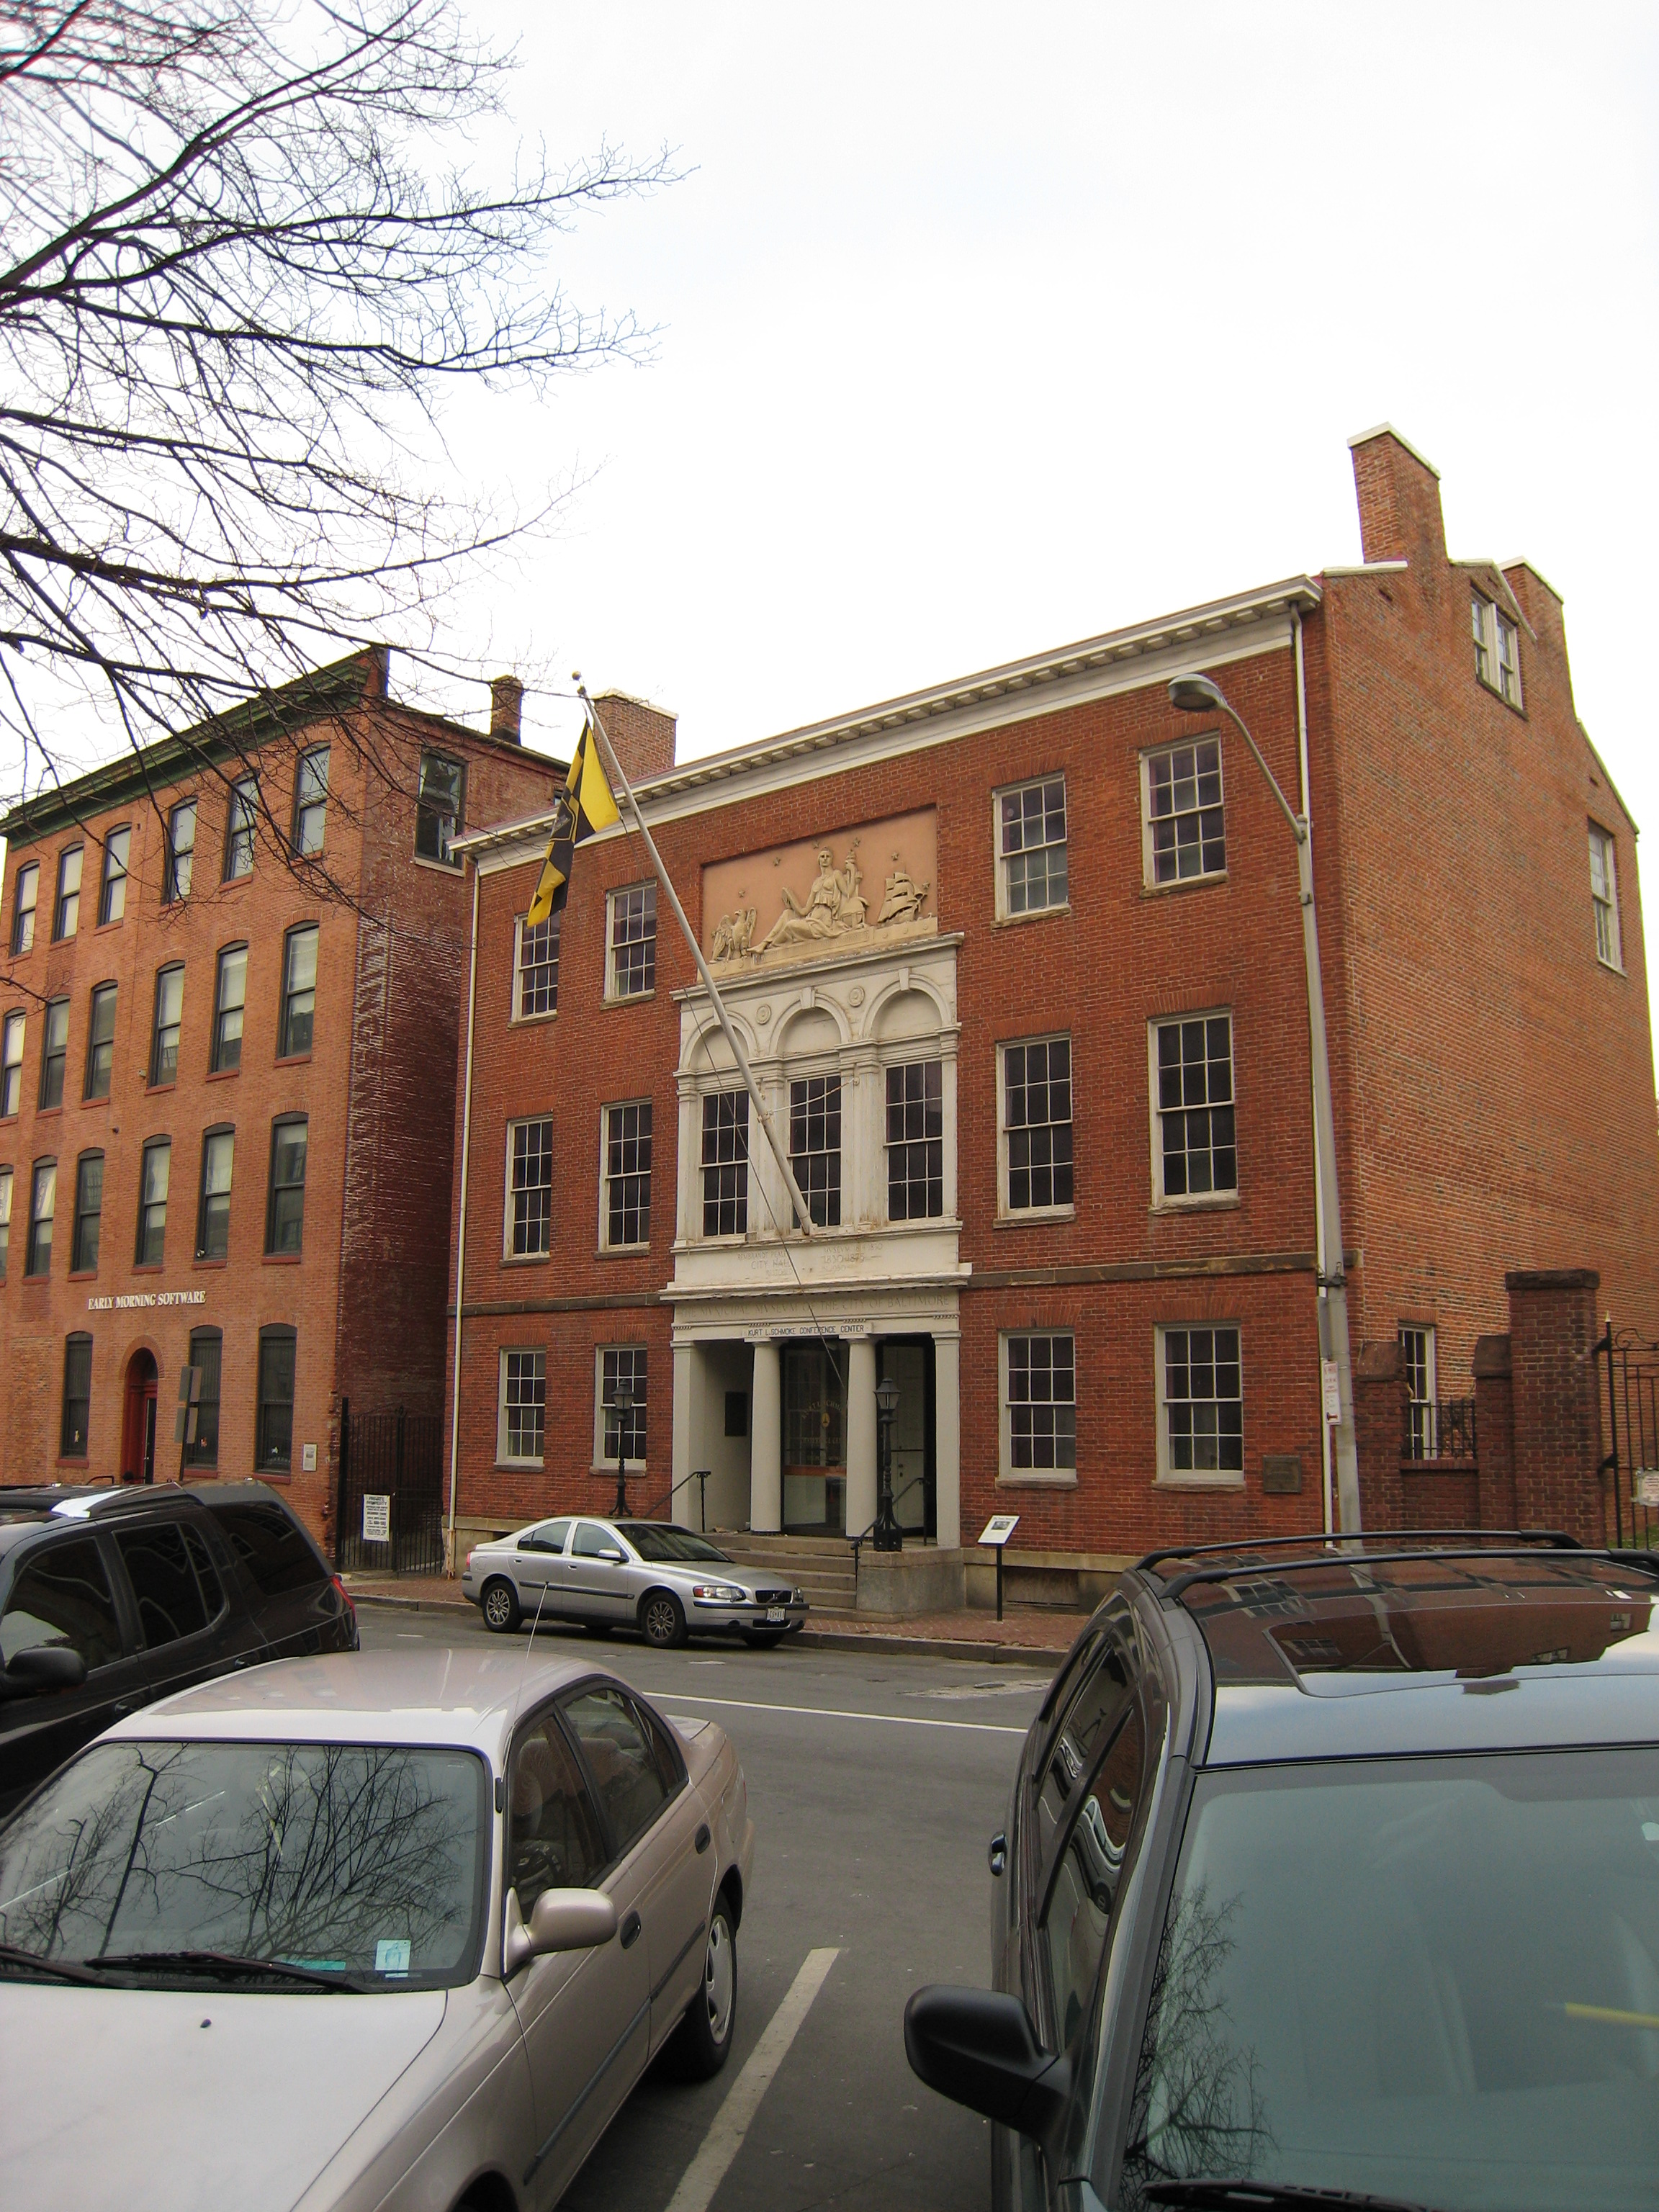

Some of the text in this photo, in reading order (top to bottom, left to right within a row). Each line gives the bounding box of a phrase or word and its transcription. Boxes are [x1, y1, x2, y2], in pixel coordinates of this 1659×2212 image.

[751, 1259, 768, 1269] CITY
[87, 1290, 206, 1310] EARLY MORNING SOFTWARE
[820, 1300, 839, 1310] THE
[842, 1298, 864, 1310] CITY
[869, 1297, 883, 1308] OF
[887, 1295, 949, 1308] BALTIMORE
[799, 1326, 836, 1334] CONFERENCE
[840, 1324, 864, 1333] CENTER
